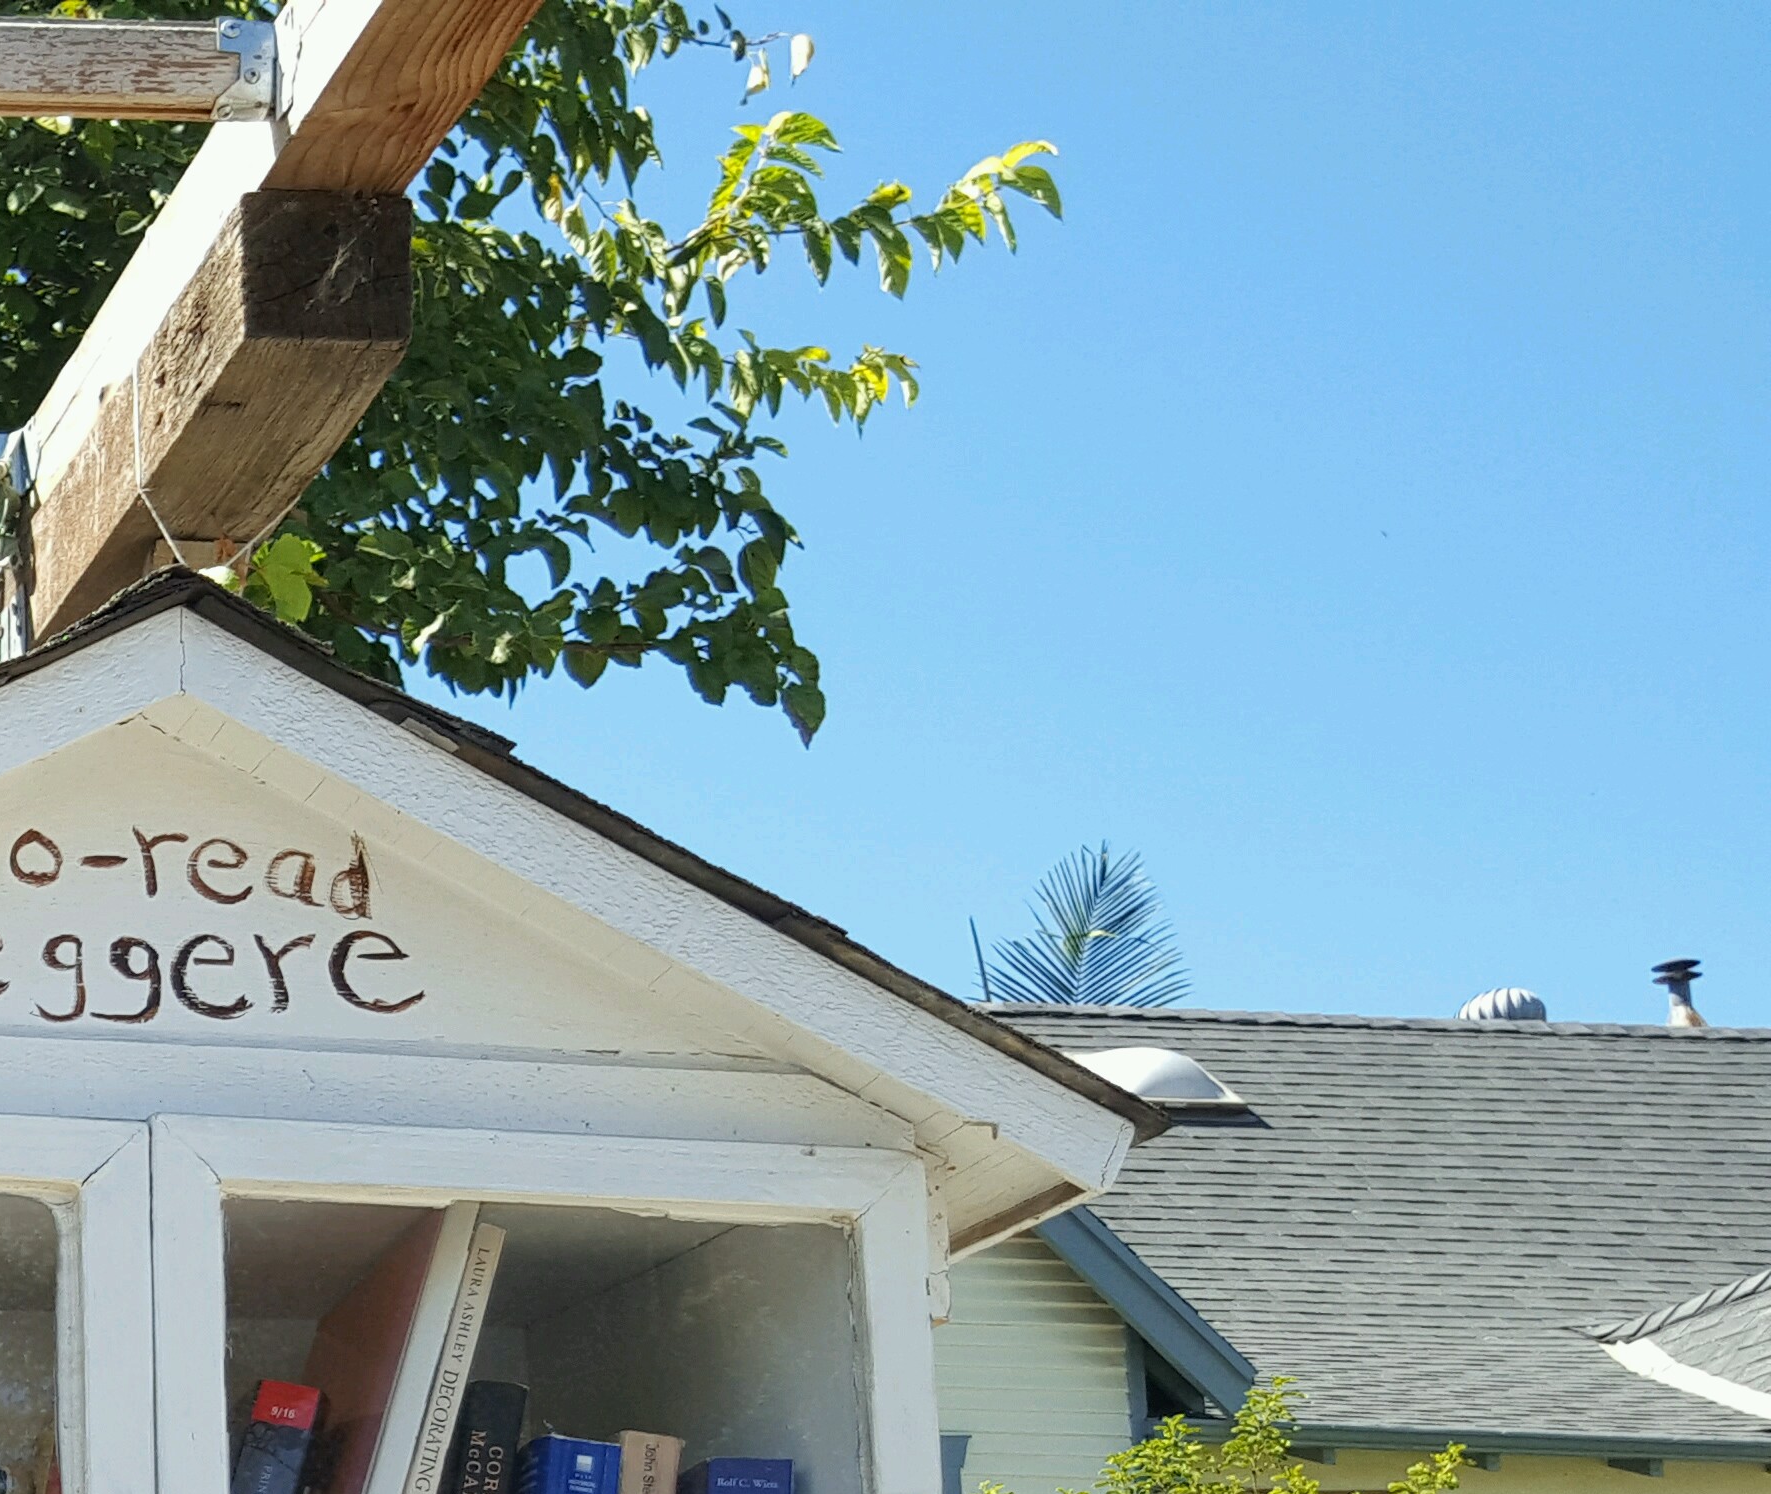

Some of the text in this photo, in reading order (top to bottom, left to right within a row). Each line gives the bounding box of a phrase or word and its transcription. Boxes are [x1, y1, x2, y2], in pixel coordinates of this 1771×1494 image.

[467, 1247, 491, 1298] LAURA
[451, 1301, 477, 1363] ASHLEY
[270, 1405, 297, 1420] 9/16
[412, 1369, 460, 1493] DECORATING
[645, 1442, 661, 1471] John
